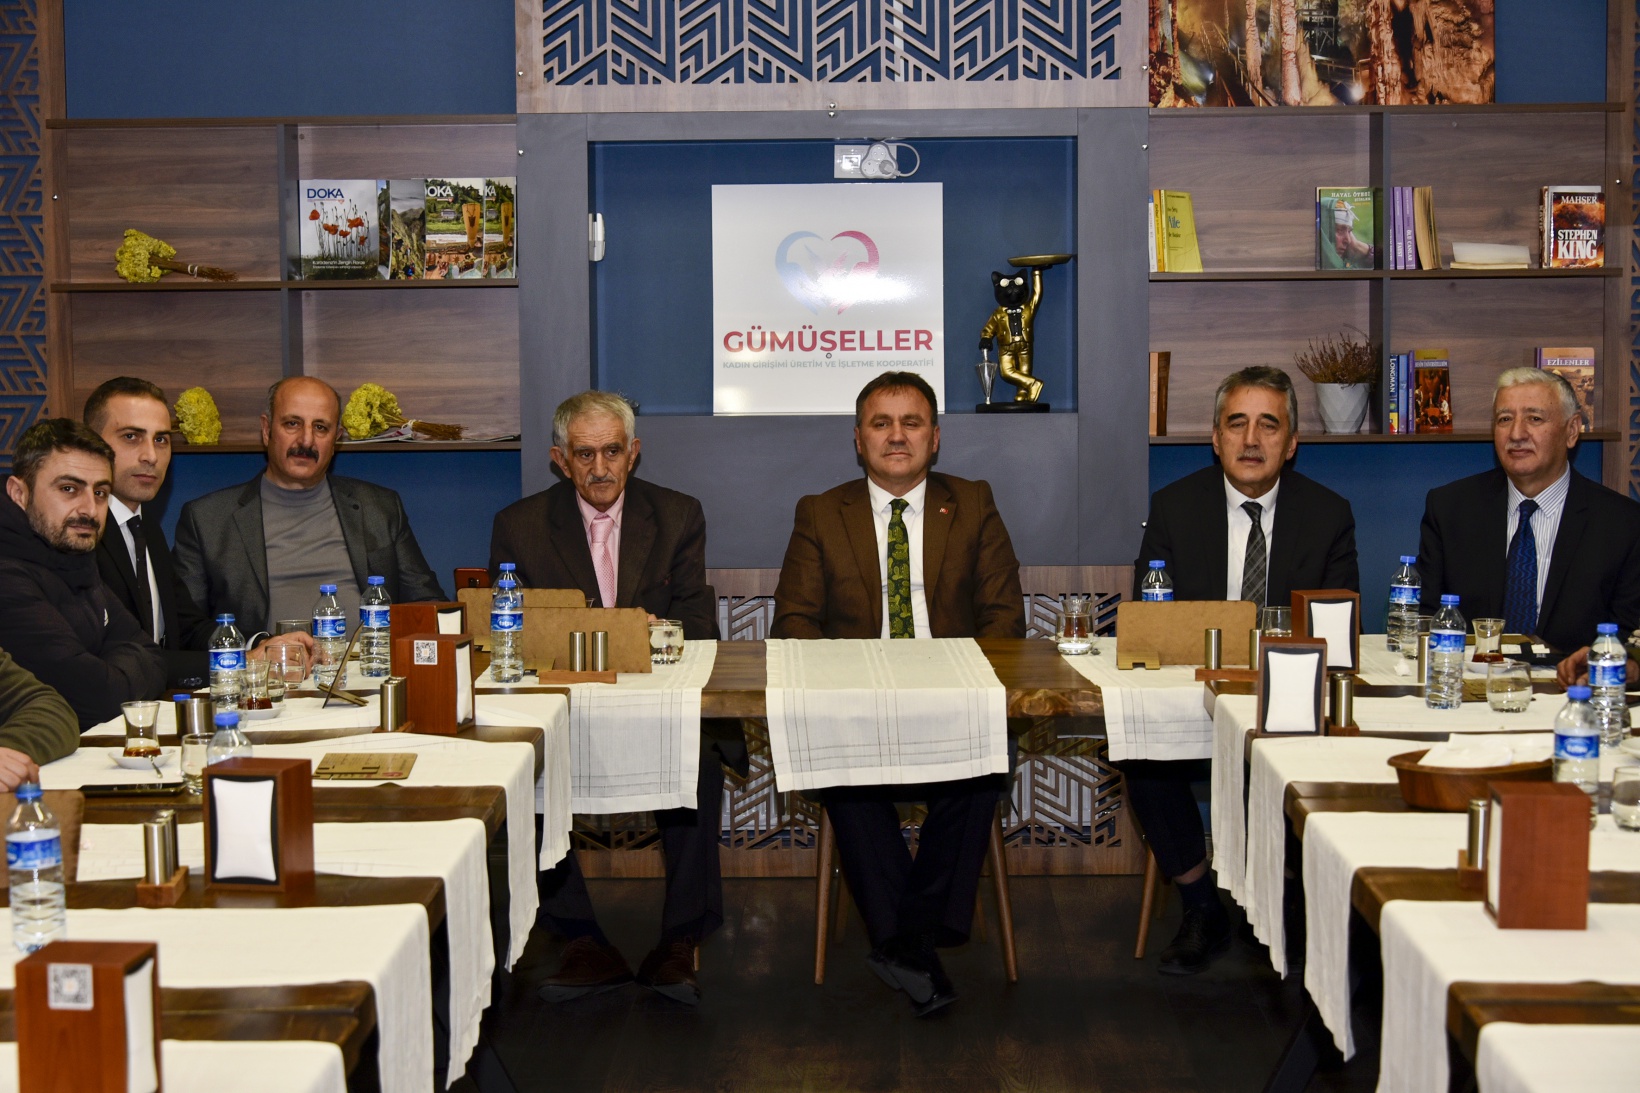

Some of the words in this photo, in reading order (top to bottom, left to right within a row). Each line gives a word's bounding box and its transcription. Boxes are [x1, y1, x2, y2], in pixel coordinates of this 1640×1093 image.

[307, 188, 344, 199] DOKA
[1557, 230, 1598, 240] STEPHEN
[1557, 240, 1597, 260] KING
[723, 325, 933, 354] GÜMÜŞELLER
[752, 360, 788, 369] GİRİŞİMİ
[790, 359, 822, 368] ÜRETİM
[838, 359, 874, 368] İŞLETME
[876, 357, 934, 367] KOOPERATİFİ
